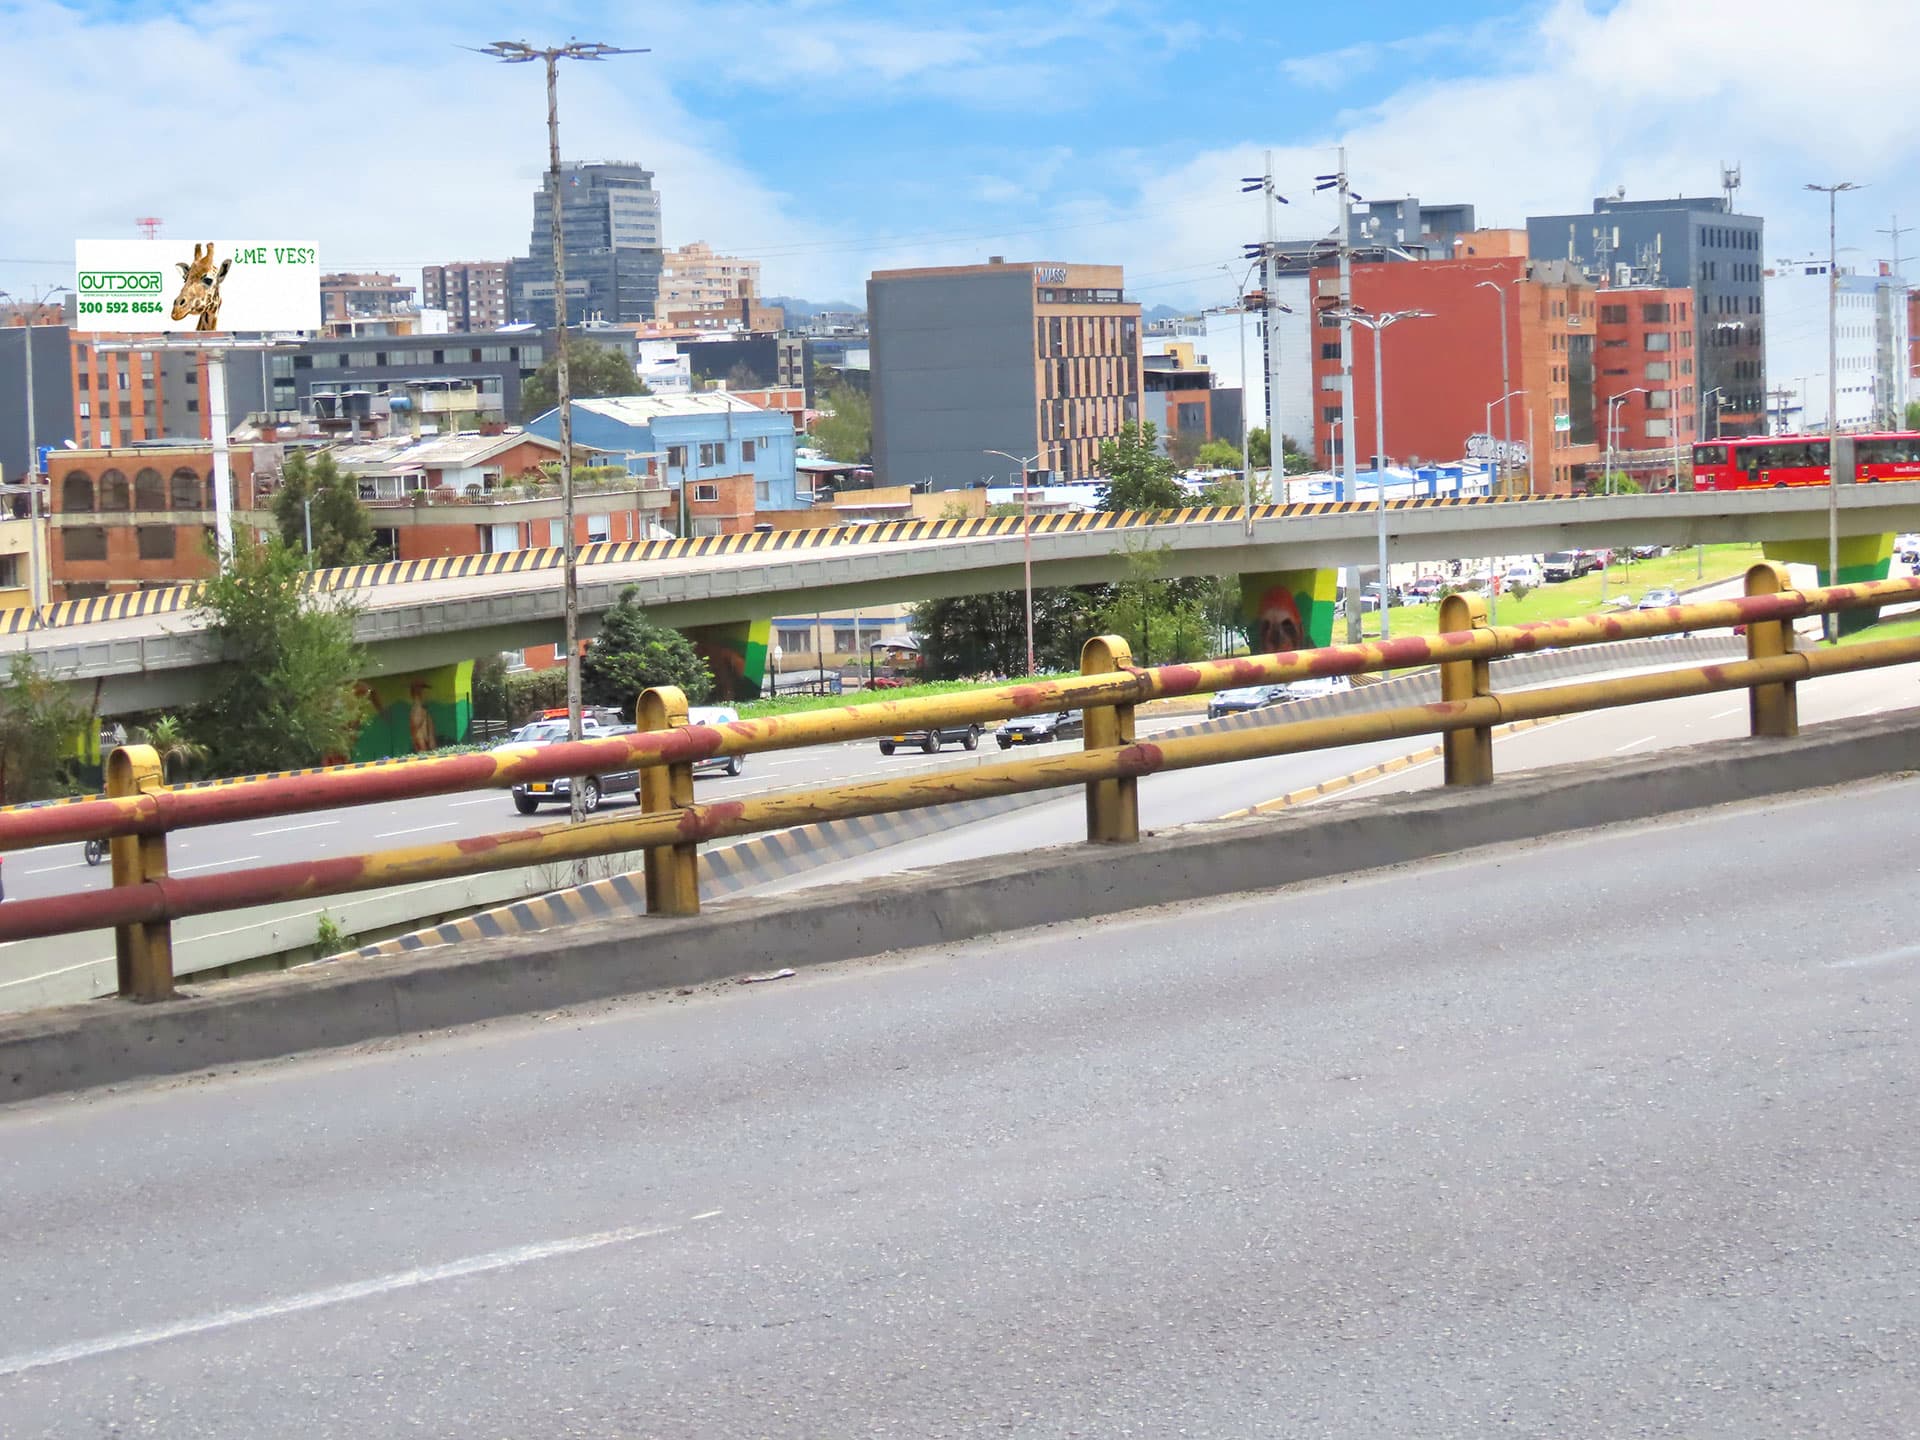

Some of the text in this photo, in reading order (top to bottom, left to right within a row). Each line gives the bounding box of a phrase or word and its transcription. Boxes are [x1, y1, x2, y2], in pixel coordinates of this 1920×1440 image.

[234, 247, 315, 264] ¿ME VES?
[81, 275, 160, 289] OUTDOOR
[79, 301, 163, 313] 300 592 8654
